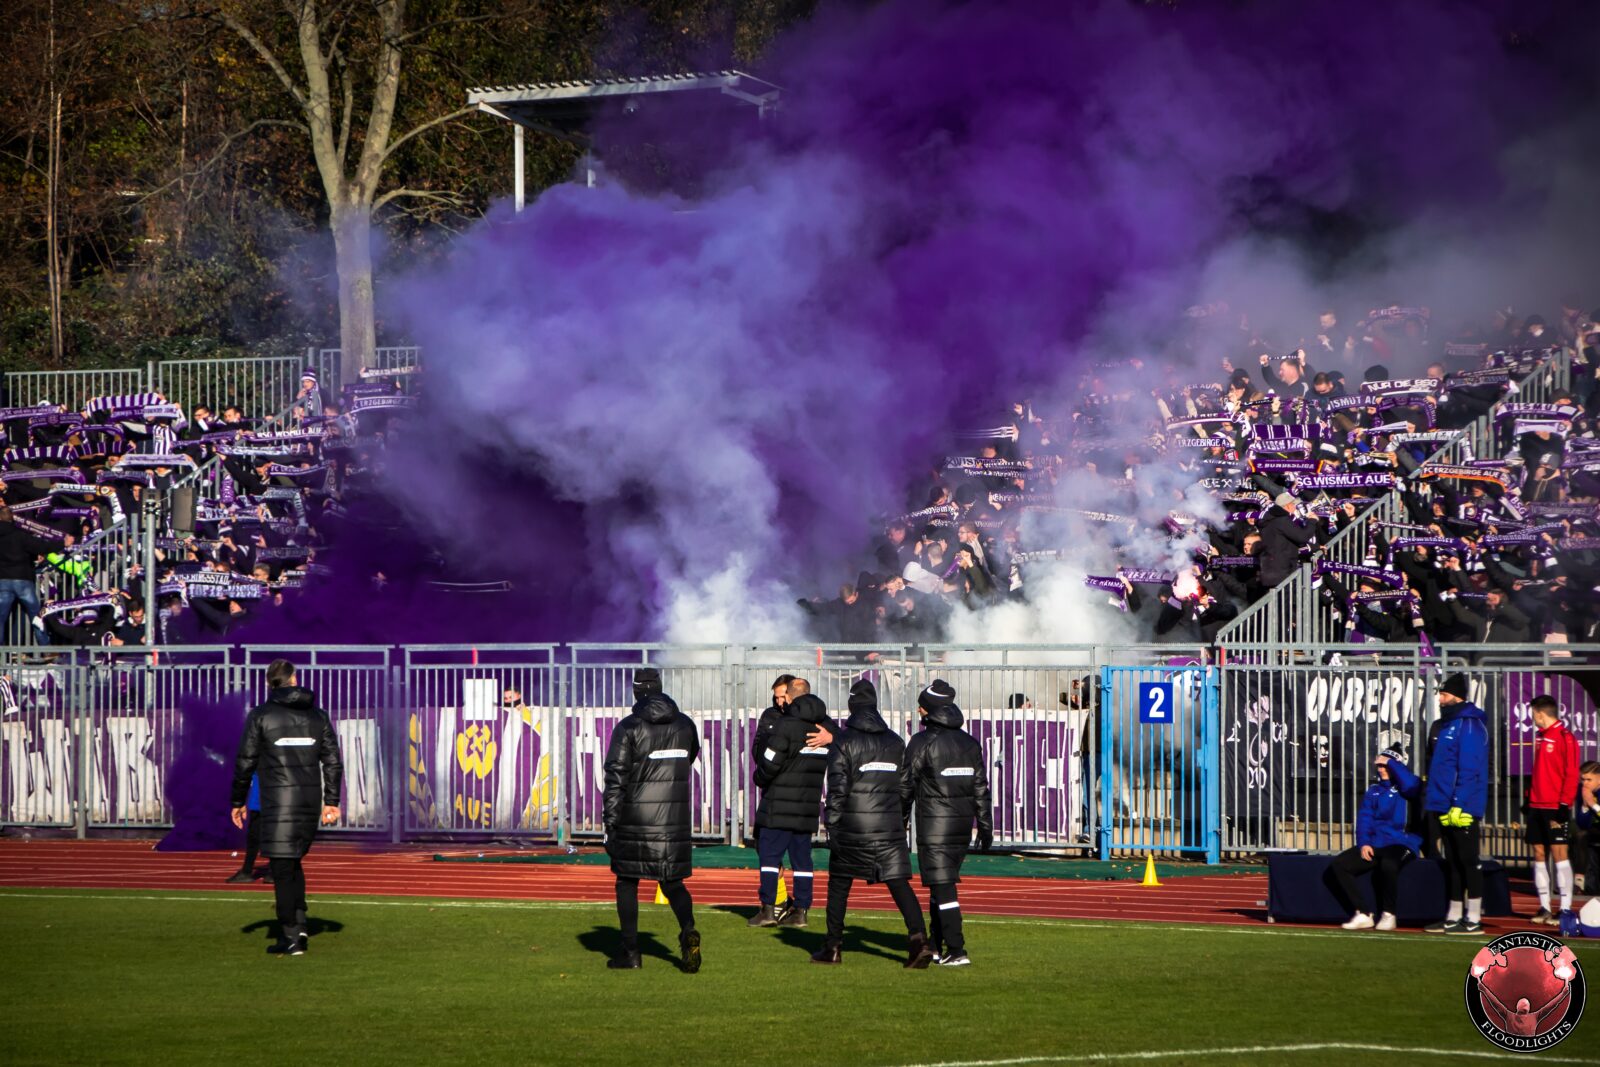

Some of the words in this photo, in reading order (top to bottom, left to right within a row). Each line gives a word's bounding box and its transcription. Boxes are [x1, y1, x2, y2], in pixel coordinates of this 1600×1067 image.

[1434, 467, 1482, 476] ERZGEBIRGE
[1313, 475, 1363, 485] WISMUT
[1365, 474, 1391, 484] AUE
[1336, 562, 1380, 575] Erzgebirge
[1148, 687, 1165, 718] 2
[455, 794, 492, 826] AUE
